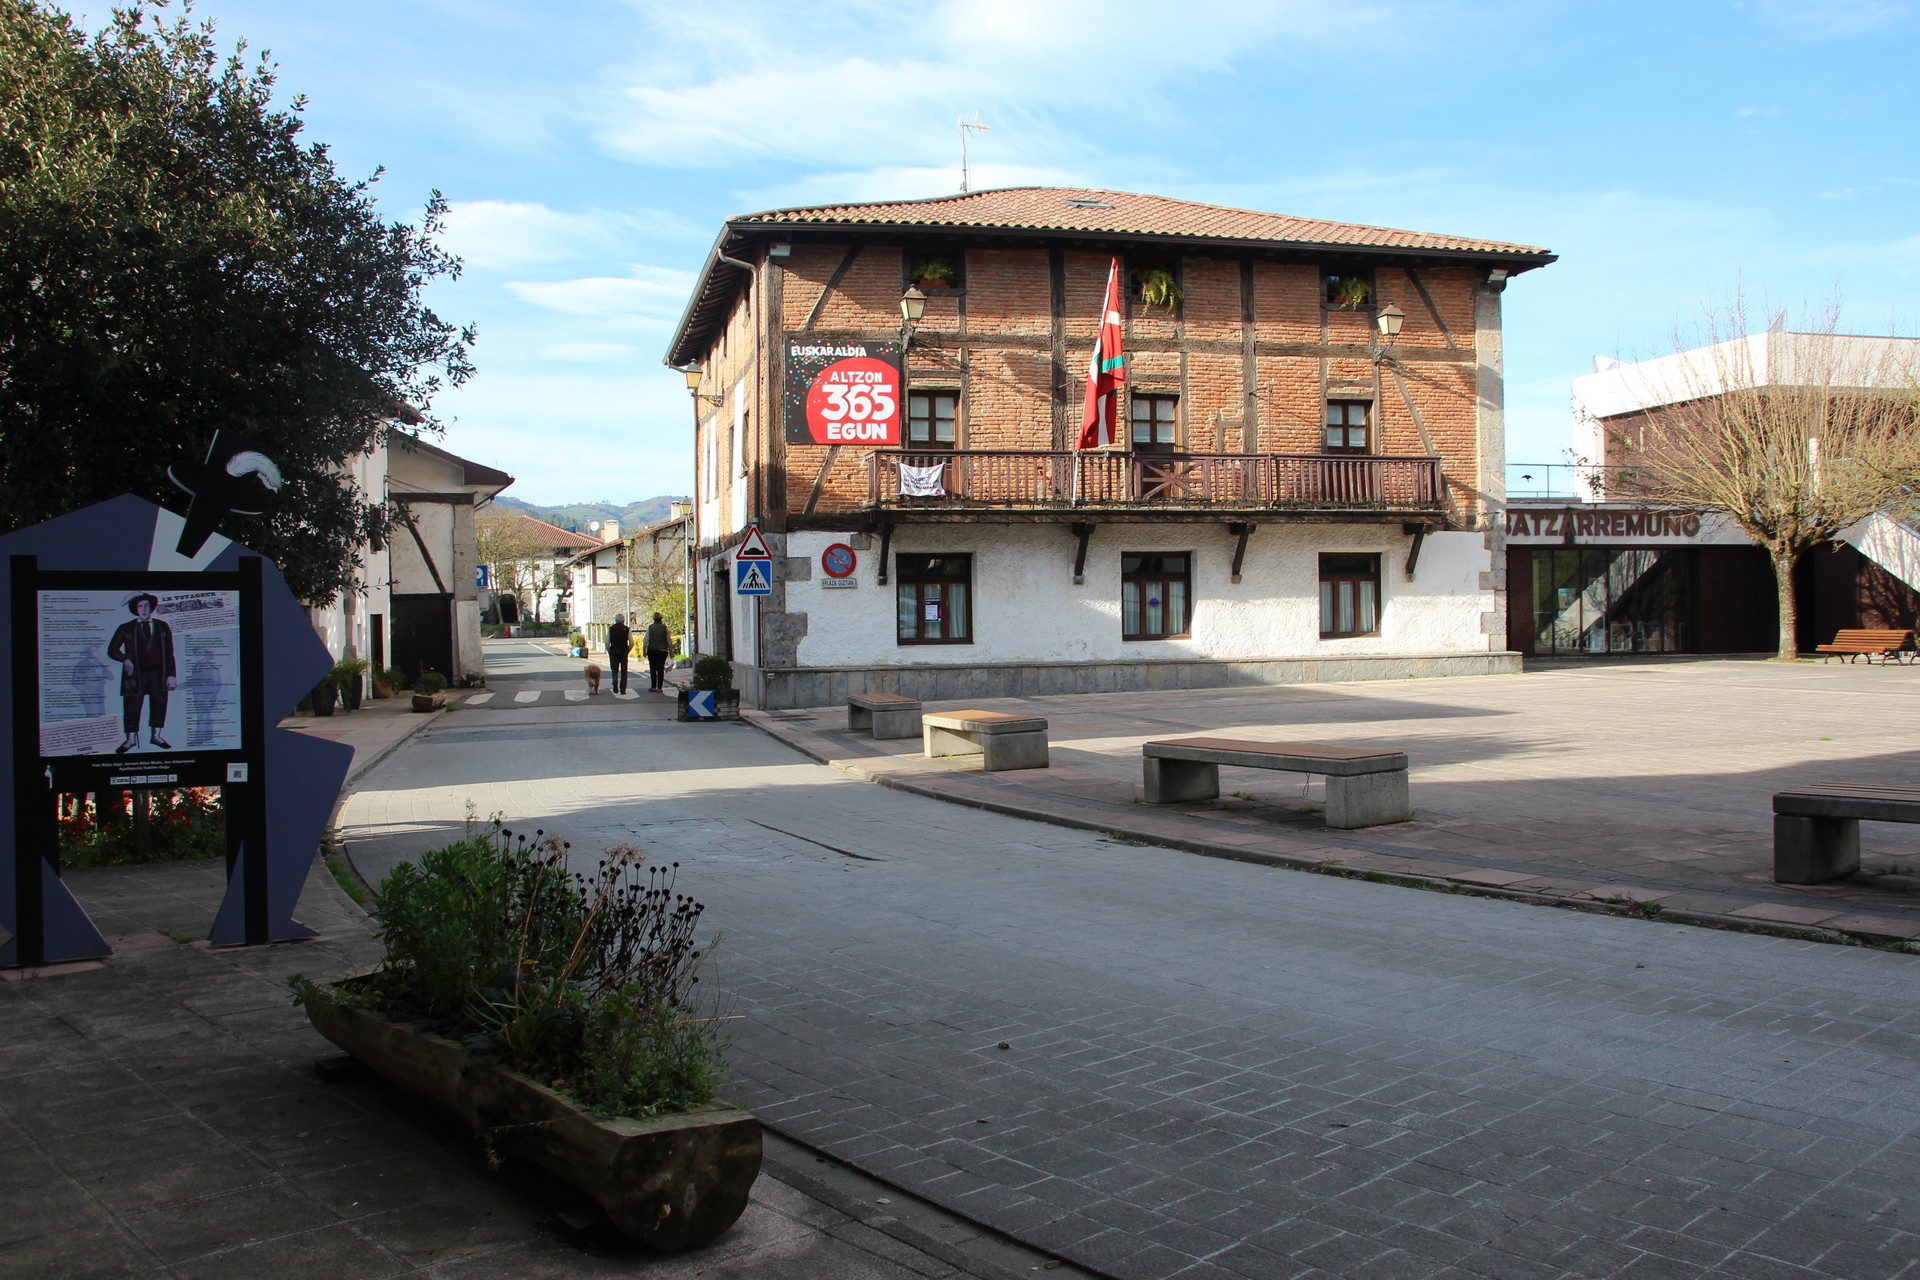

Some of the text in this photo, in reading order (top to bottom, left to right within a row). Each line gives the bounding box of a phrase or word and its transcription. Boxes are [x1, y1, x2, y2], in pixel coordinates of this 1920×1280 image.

[791, 346, 867, 357] EUSKARALDIA
[830, 371, 883, 382] ALTZON
[820, 383, 896, 421] 365
[827, 422, 887, 440] EGUN
[174, 592, 216, 601] VOYAGEUR
